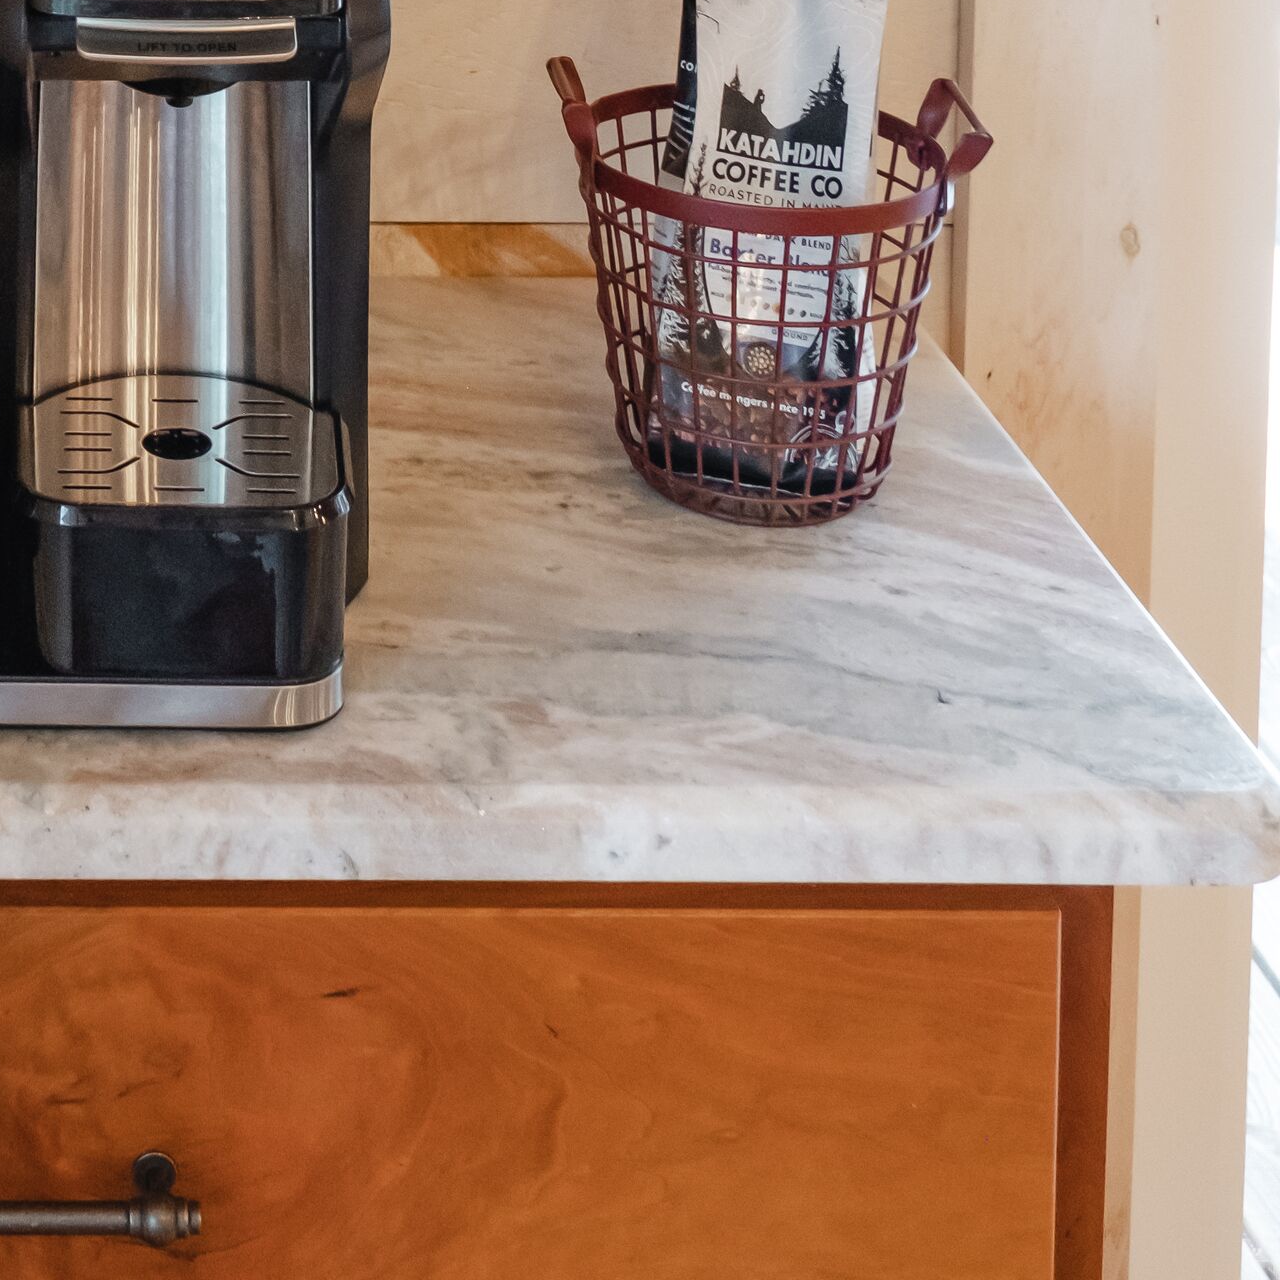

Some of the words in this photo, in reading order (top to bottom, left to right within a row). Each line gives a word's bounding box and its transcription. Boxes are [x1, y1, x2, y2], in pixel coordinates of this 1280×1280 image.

[138, 41, 167, 52] LIFT
[173, 42, 193, 52] TO
[196, 41, 237, 53] OPEN
[719, 127, 842, 169] KATAHDIN
[712, 157, 800, 194] COFFEE
[811, 174, 843, 199] CO
[708, 183, 774, 206] ROASTED
[781, 198, 796, 209] IN
[801, 238, 832, 251] BLEND
[681, 381, 717, 398] Cofee
[718, 391, 768, 408] mngers
[802, 406, 827, 420] 195
